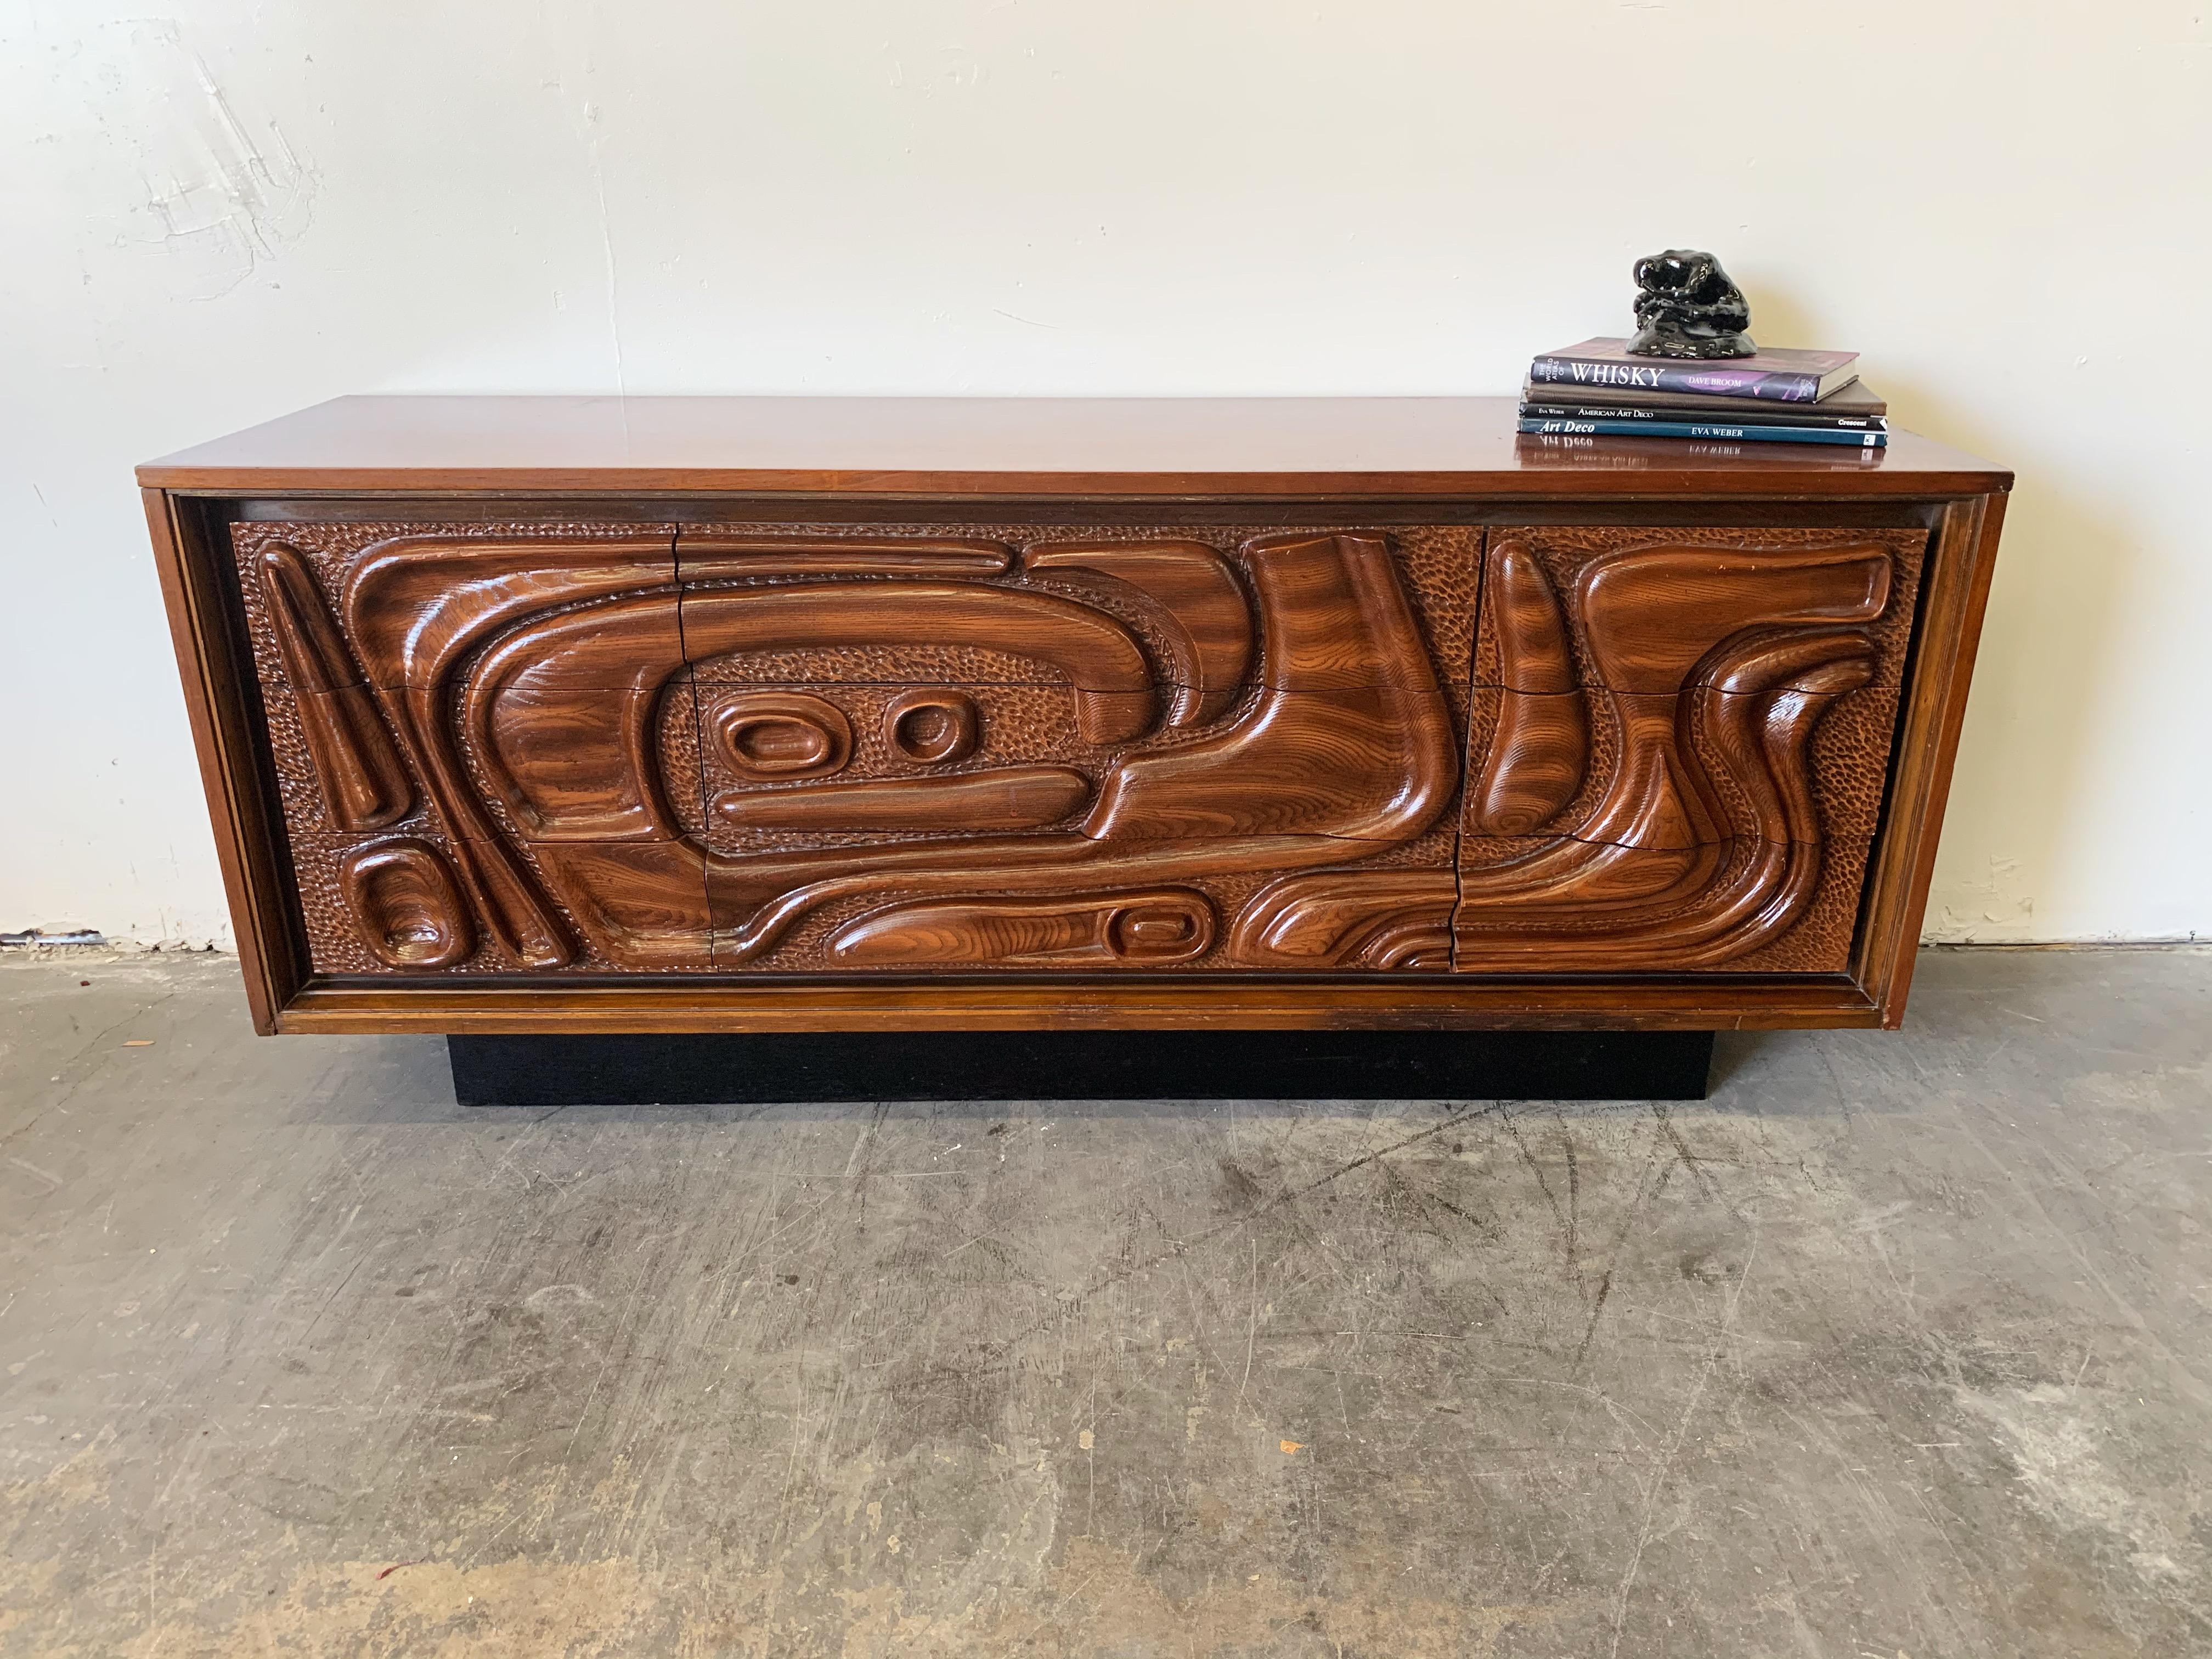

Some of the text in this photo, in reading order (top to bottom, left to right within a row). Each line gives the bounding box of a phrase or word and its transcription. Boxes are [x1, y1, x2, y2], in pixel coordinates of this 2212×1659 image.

[1551, 360, 1560, 380] ATLAS
[1558, 365, 1565, 376] OF
[1571, 363, 1665, 387] WHISKY
[1689, 376, 1741, 387] DAVE BROOM
[1540, 420, 1595, 433] Art Deco
[1691, 427, 1743, 437] EVA WEBER
